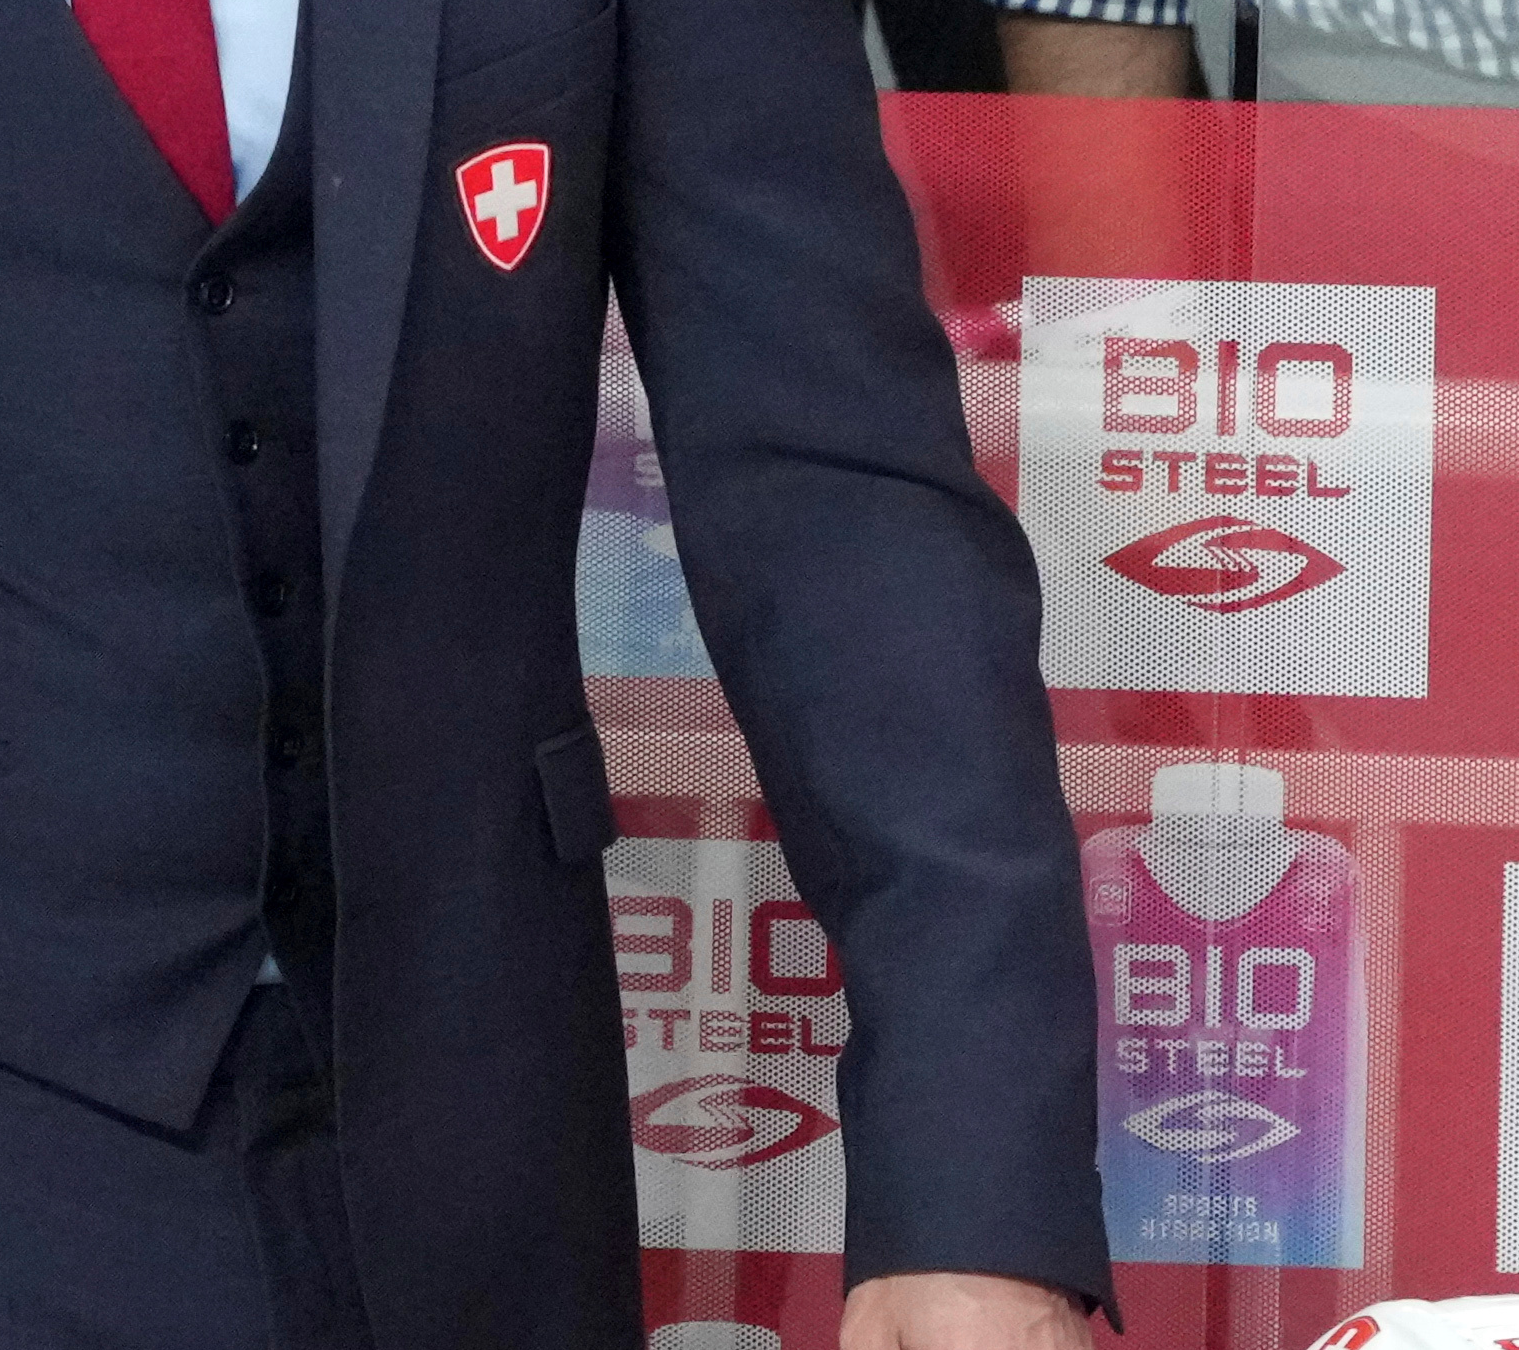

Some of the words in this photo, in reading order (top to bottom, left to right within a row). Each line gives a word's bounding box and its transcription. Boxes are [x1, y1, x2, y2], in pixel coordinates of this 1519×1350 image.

[1103, 338, 1352, 439] BIO
[1100, 451, 1350, 498] STEEL
[1115, 942, 1316, 1030] BIO
[1116, 1038, 1306, 1078] STEEL
